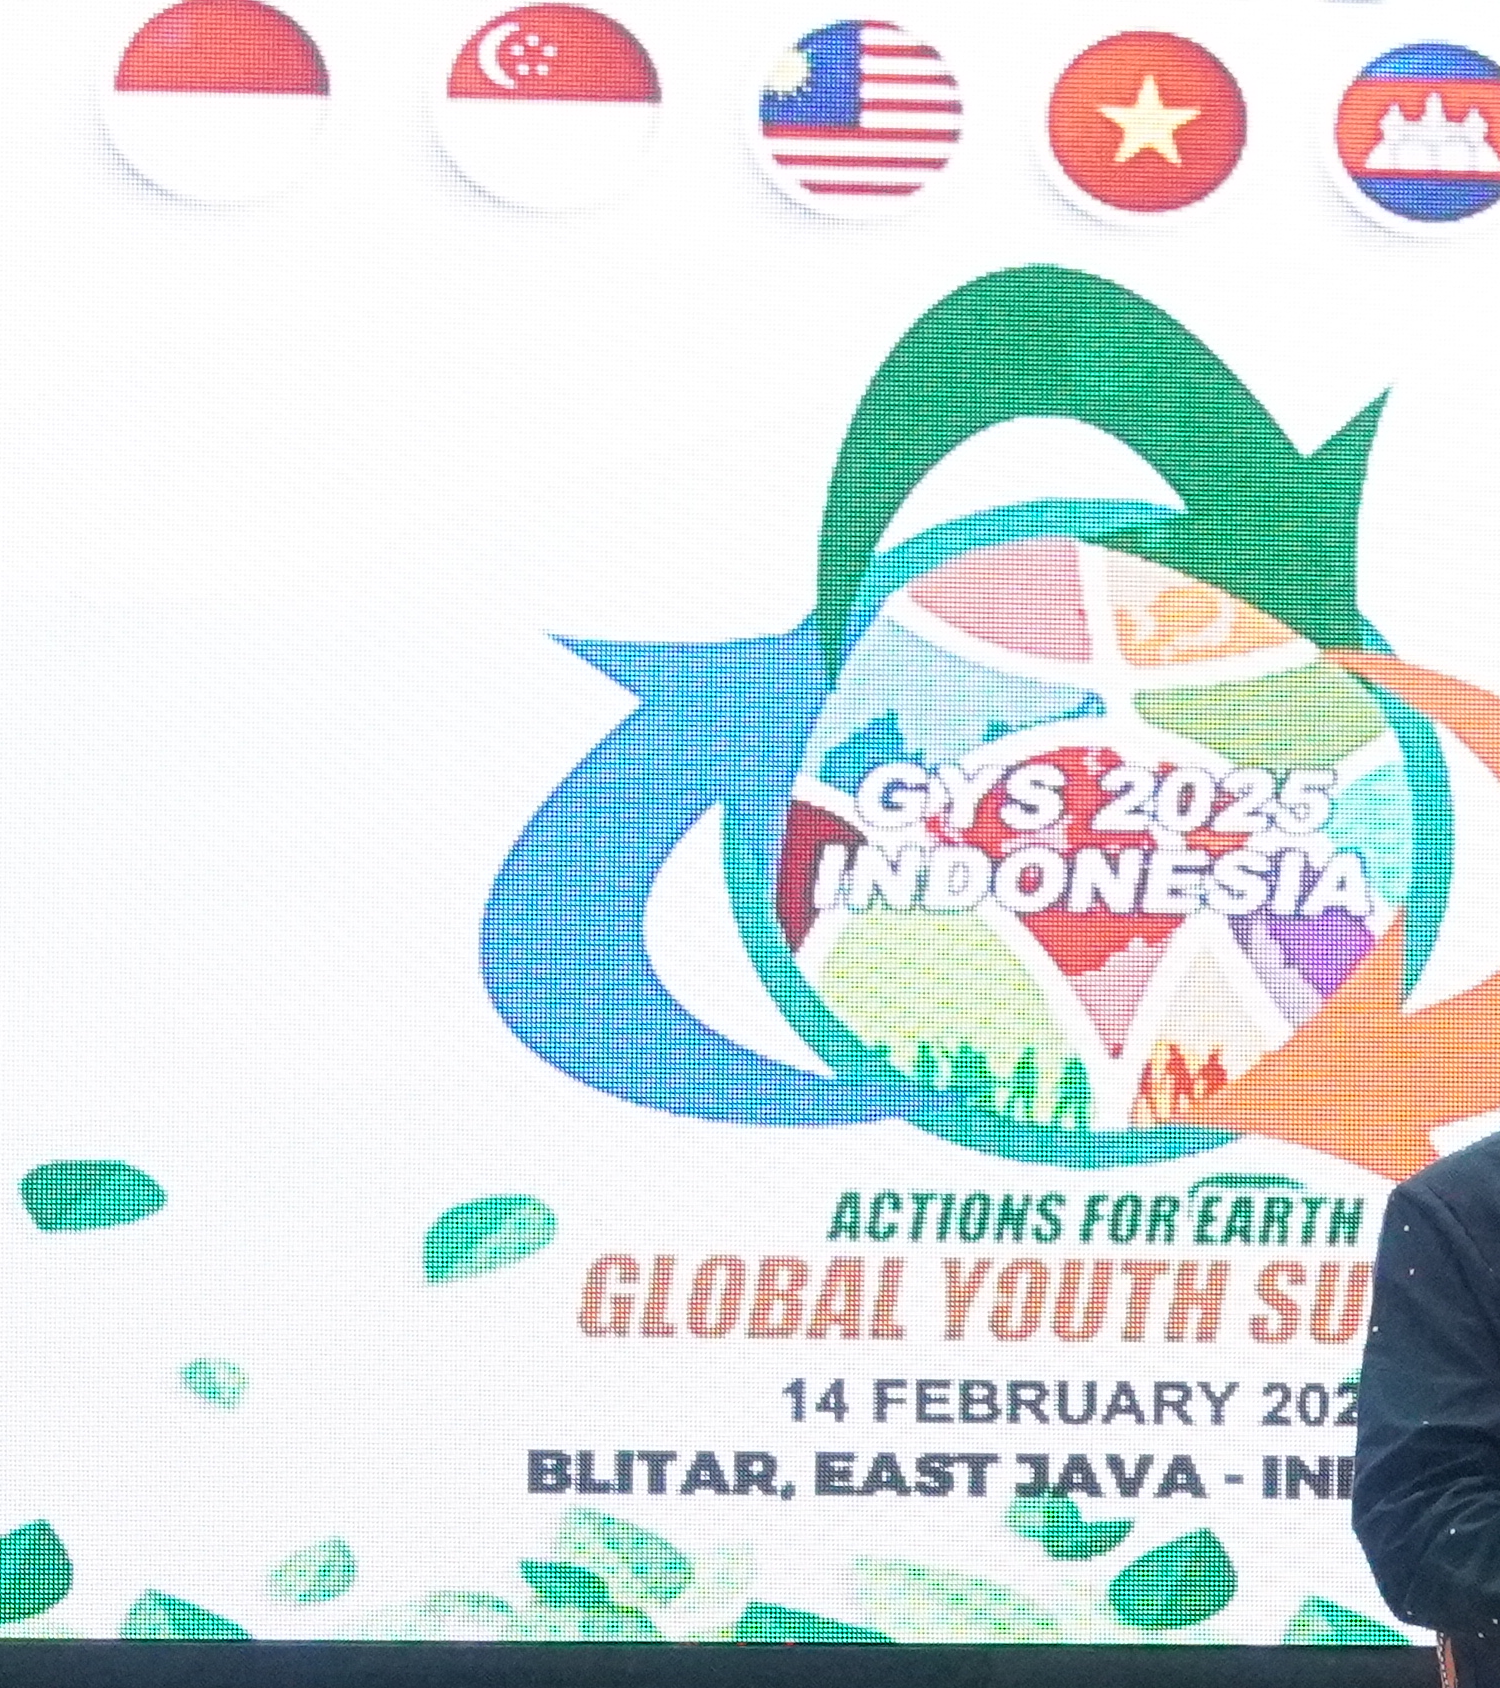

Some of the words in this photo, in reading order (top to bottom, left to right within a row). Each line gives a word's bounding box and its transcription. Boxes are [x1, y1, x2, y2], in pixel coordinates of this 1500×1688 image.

[854, 761, 1068, 832] GYS
[1093, 763, 1339, 835] 2025
[811, 841, 1373, 917] INDONESIA
[826, 1188, 1066, 1244] ACTIONS
[1078, 1191, 1180, 1244] FOR
[1192, 1195, 1364, 1246] EARTH
[579, 1253, 907, 1341] GLOBAL
[942, 1257, 1231, 1343] YOUTH
[782, 1378, 849, 1423] 14
[873, 1378, 1240, 1426] FEBRUARY
[527, 1449, 796, 1499] BLITAR,
[814, 1451, 1000, 1497] EAST
[1014, 1452, 1207, 1499] JAVA
